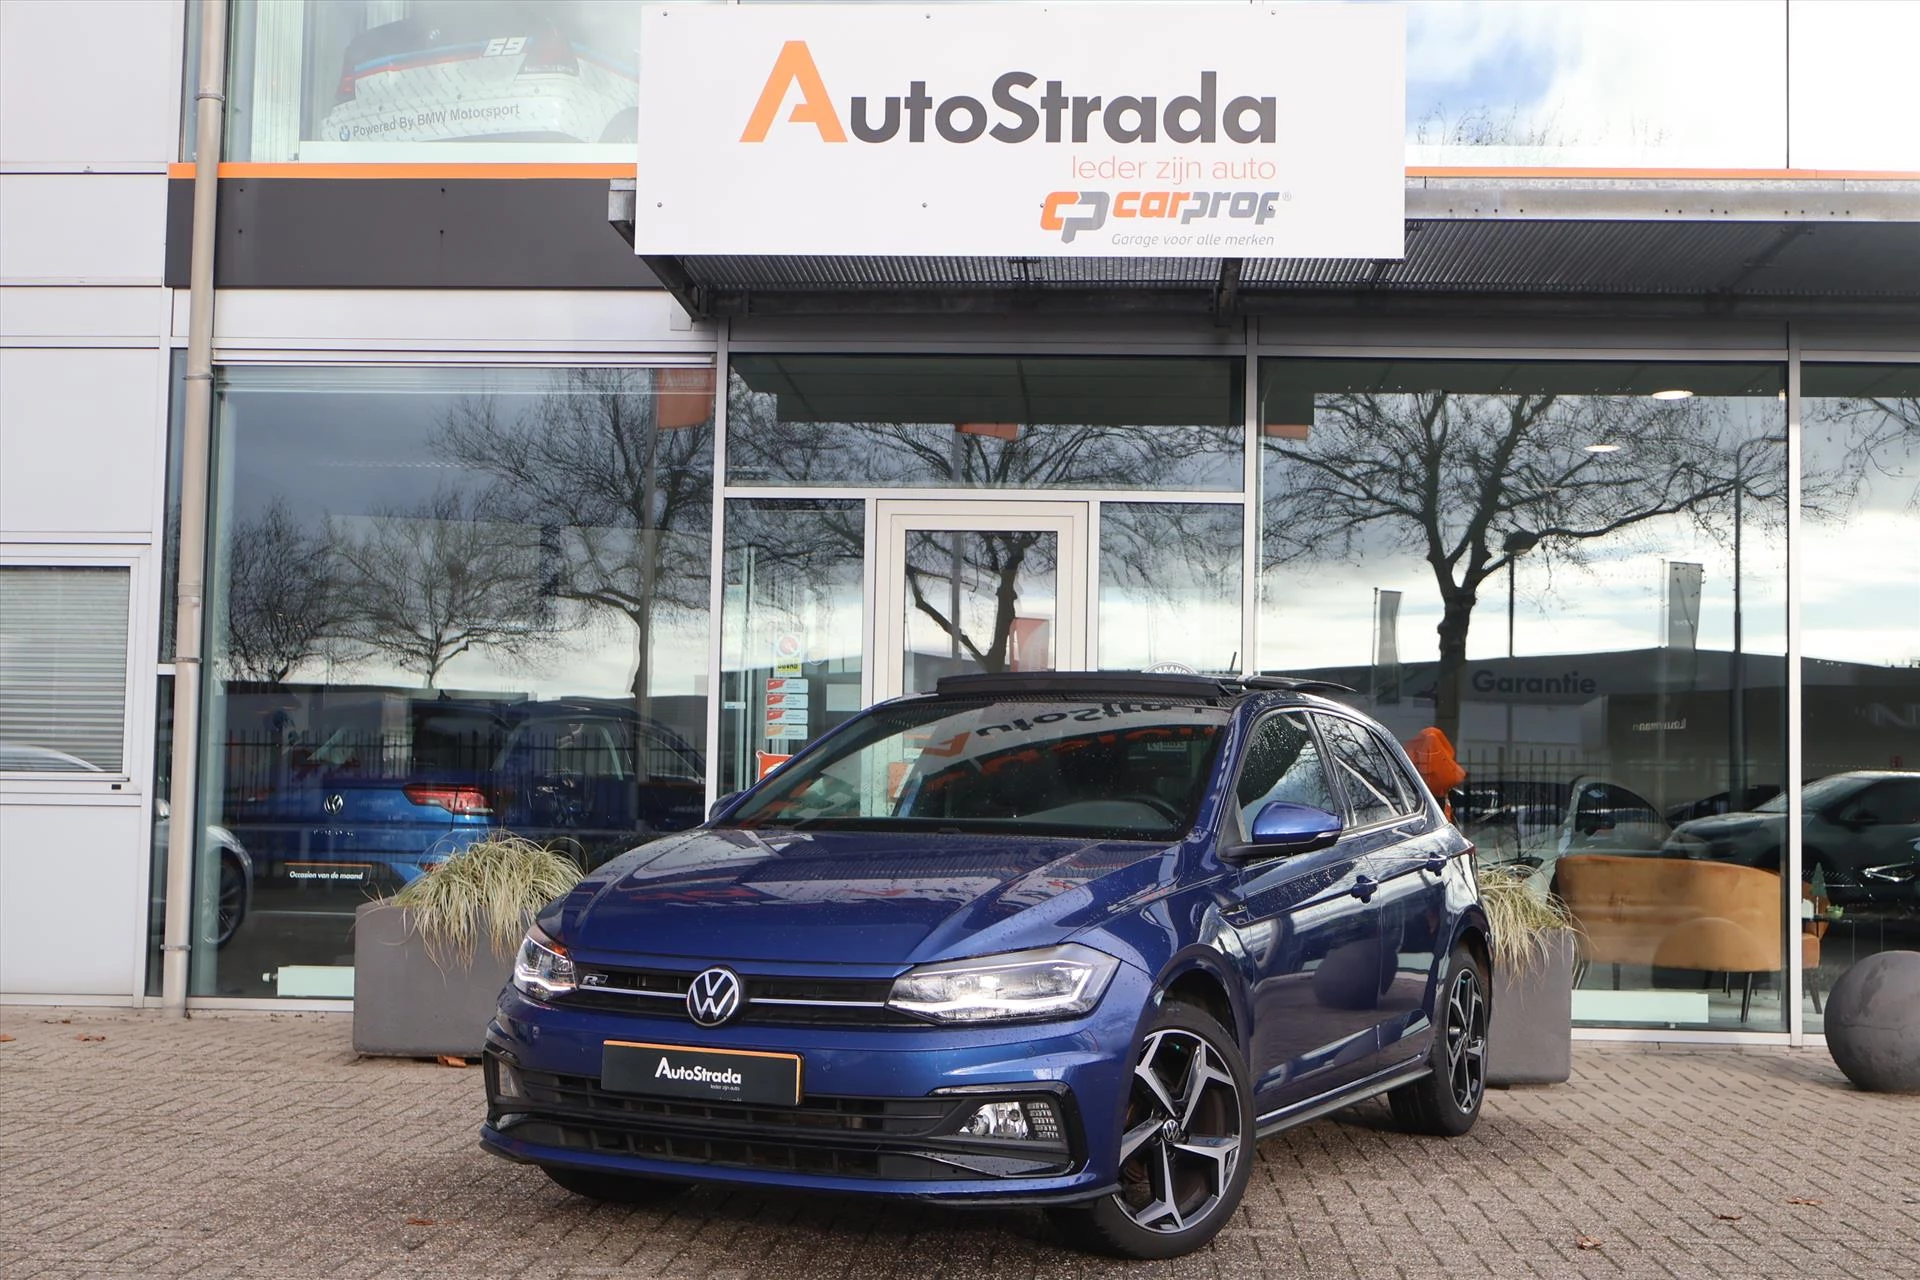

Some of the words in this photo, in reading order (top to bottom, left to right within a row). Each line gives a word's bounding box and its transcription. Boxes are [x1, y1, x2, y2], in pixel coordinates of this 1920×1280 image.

[482, 36, 528, 57] 69
[739, 40, 1277, 144] AutoStrada
[352, 121, 396, 138] Powered
[399, 116, 415, 131] By
[416, 111, 448, 126] BMW
[449, 103, 521, 122] Motorsport
[1072, 155, 1147, 180] Ieder
[1156, 156, 1202, 186] zijn
[1211, 157, 1277, 180] auto
[1111, 233, 1159, 248] Garage
[1163, 236, 1194, 246] voor
[1196, 233, 1222, 246] alle
[1224, 233, 1275, 246] merken
[1471, 669, 1597, 694] Garantie
[289, 870, 317, 879] Occasion
[330, 871, 339, 879] de
[339, 872, 364, 880] maand
[654, 1056, 742, 1084] AutoStrada
